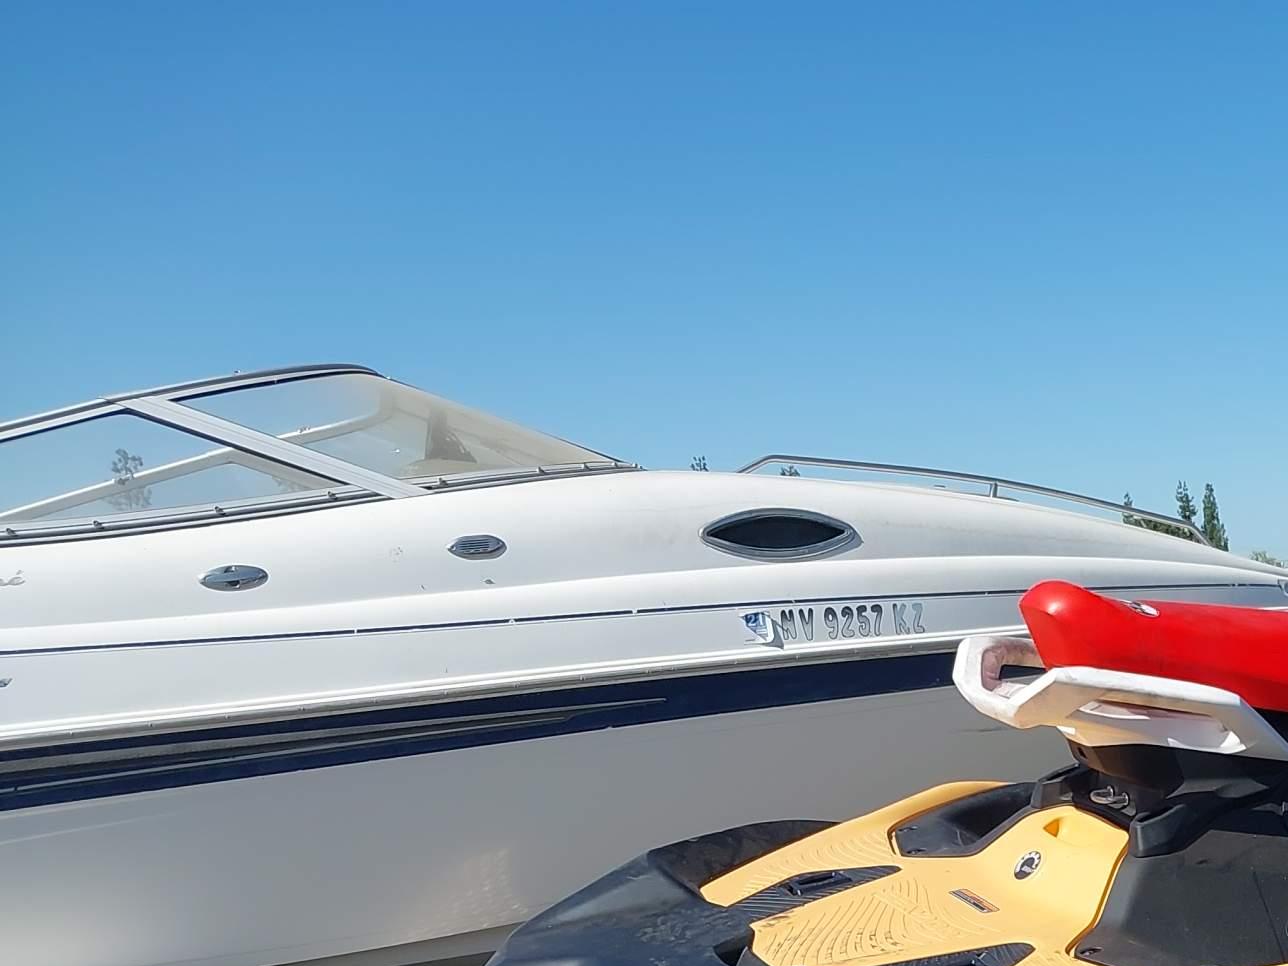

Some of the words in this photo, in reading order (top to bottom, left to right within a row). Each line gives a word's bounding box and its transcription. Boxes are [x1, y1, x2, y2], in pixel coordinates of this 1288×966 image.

[780, 607, 814, 641] NV
[823, 603, 883, 641] 9257
[892, 602, 926, 635] KZ
